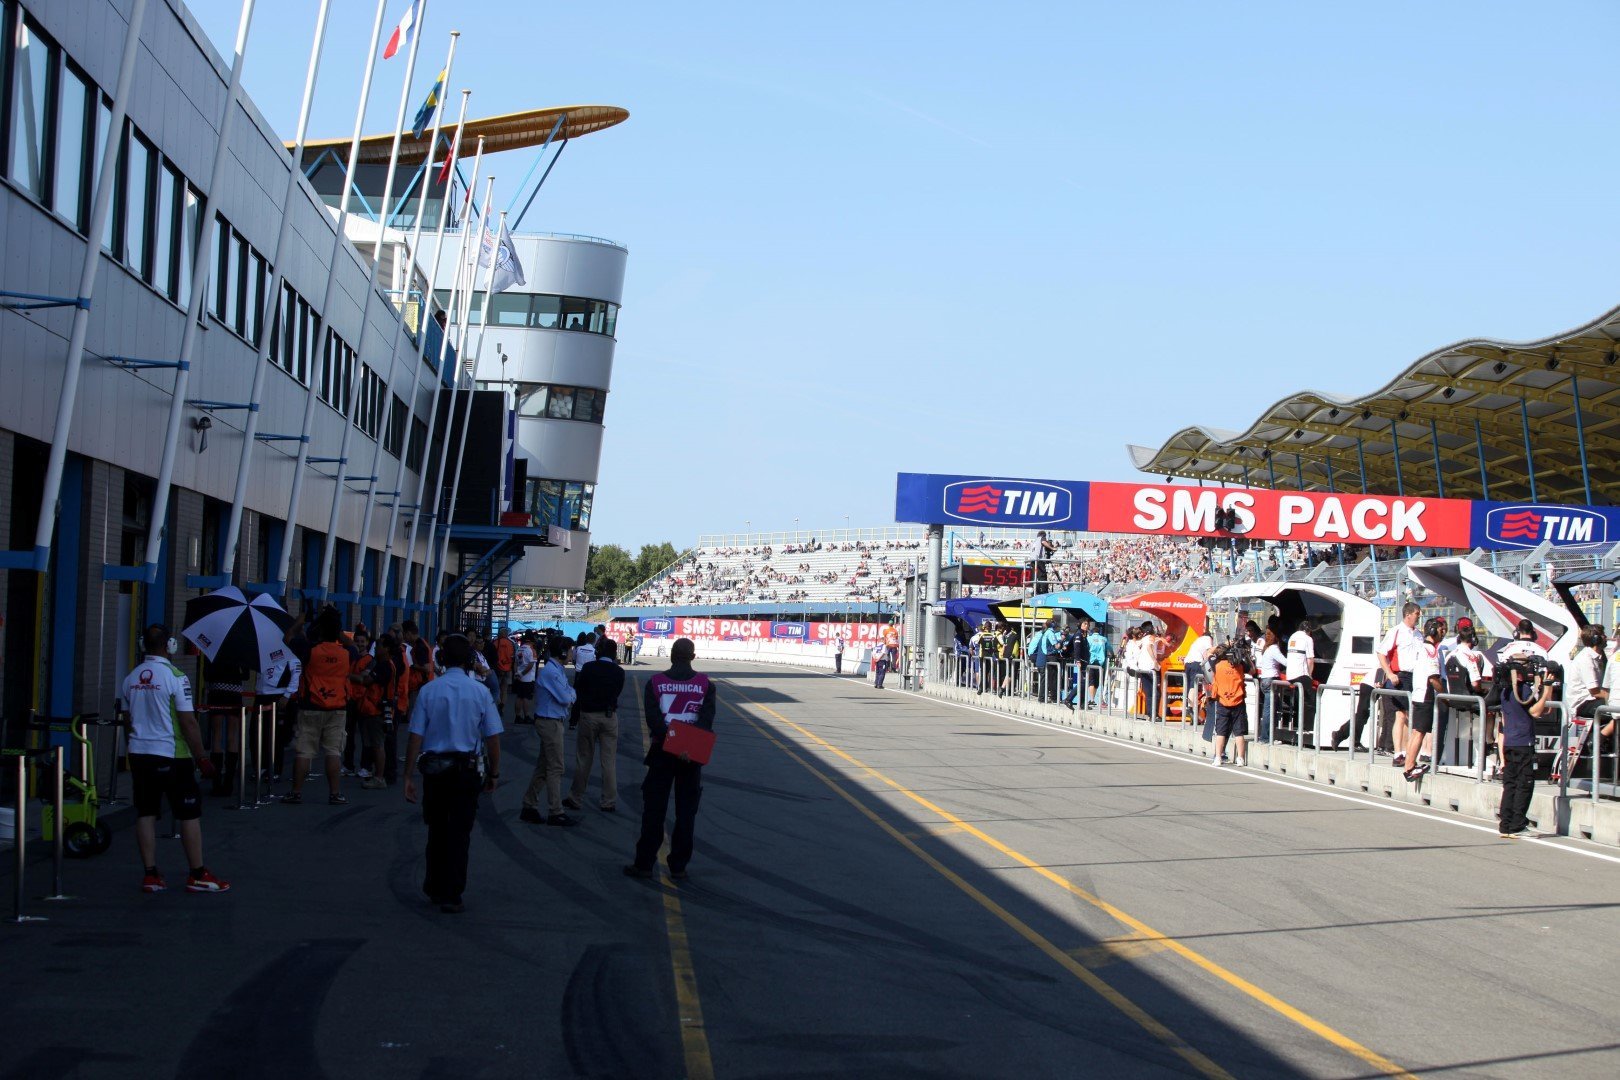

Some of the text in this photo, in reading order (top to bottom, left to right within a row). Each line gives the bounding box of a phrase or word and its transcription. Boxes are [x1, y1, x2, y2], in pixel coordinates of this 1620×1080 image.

[1003, 489, 1058, 517] TIM
[1132, 487, 1427, 543] SMS PACK
[1542, 515, 1594, 542] TIM
[1139, 600, 1171, 608] Repsol
[1173, 601, 1203, 609] Honda
[655, 621, 668, 630] TIM
[682, 618, 762, 637] SMS PACK
[788, 626, 802, 635] TIM
[817, 623, 853, 640] SMS
[657, 683, 704, 694] TECHNICAL
